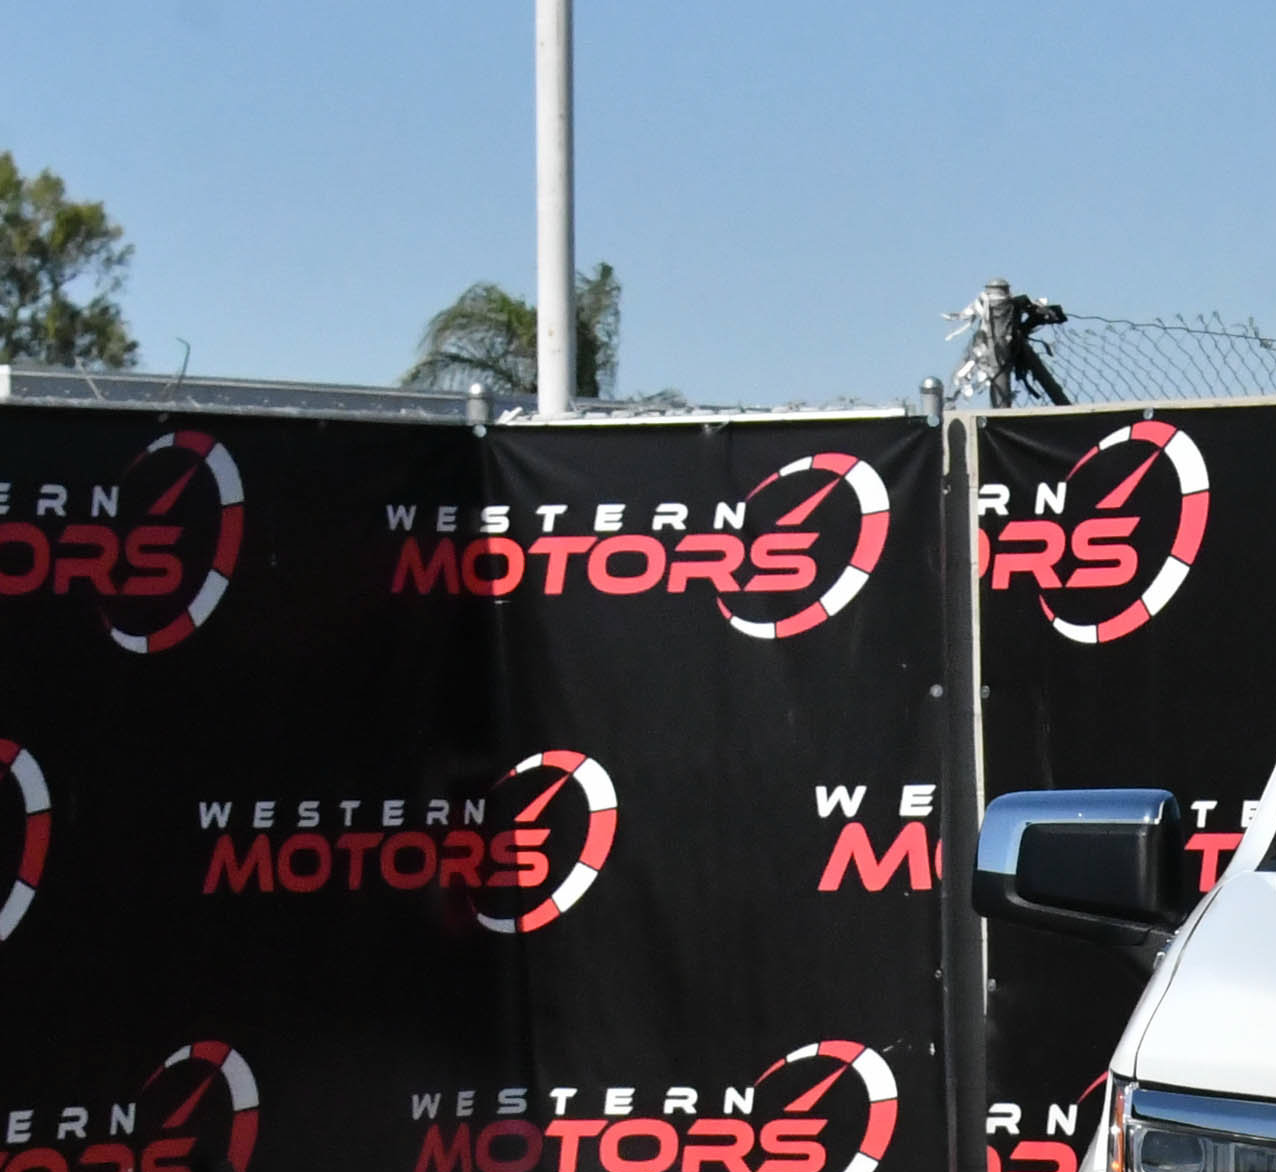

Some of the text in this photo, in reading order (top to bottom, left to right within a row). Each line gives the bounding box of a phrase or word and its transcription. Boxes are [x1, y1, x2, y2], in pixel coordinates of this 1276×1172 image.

[386, 501, 747, 532] WESTERN
[391, 532, 820, 596] MOTORS
[978, 516, 1141, 590] RS
[199, 798, 486, 829] WESTERN
[815, 784, 938, 819] WE
[203, 827, 551, 894] MOTORS
[816, 820, 945, 893] M
[411, 1085, 756, 1121] WESTERN
